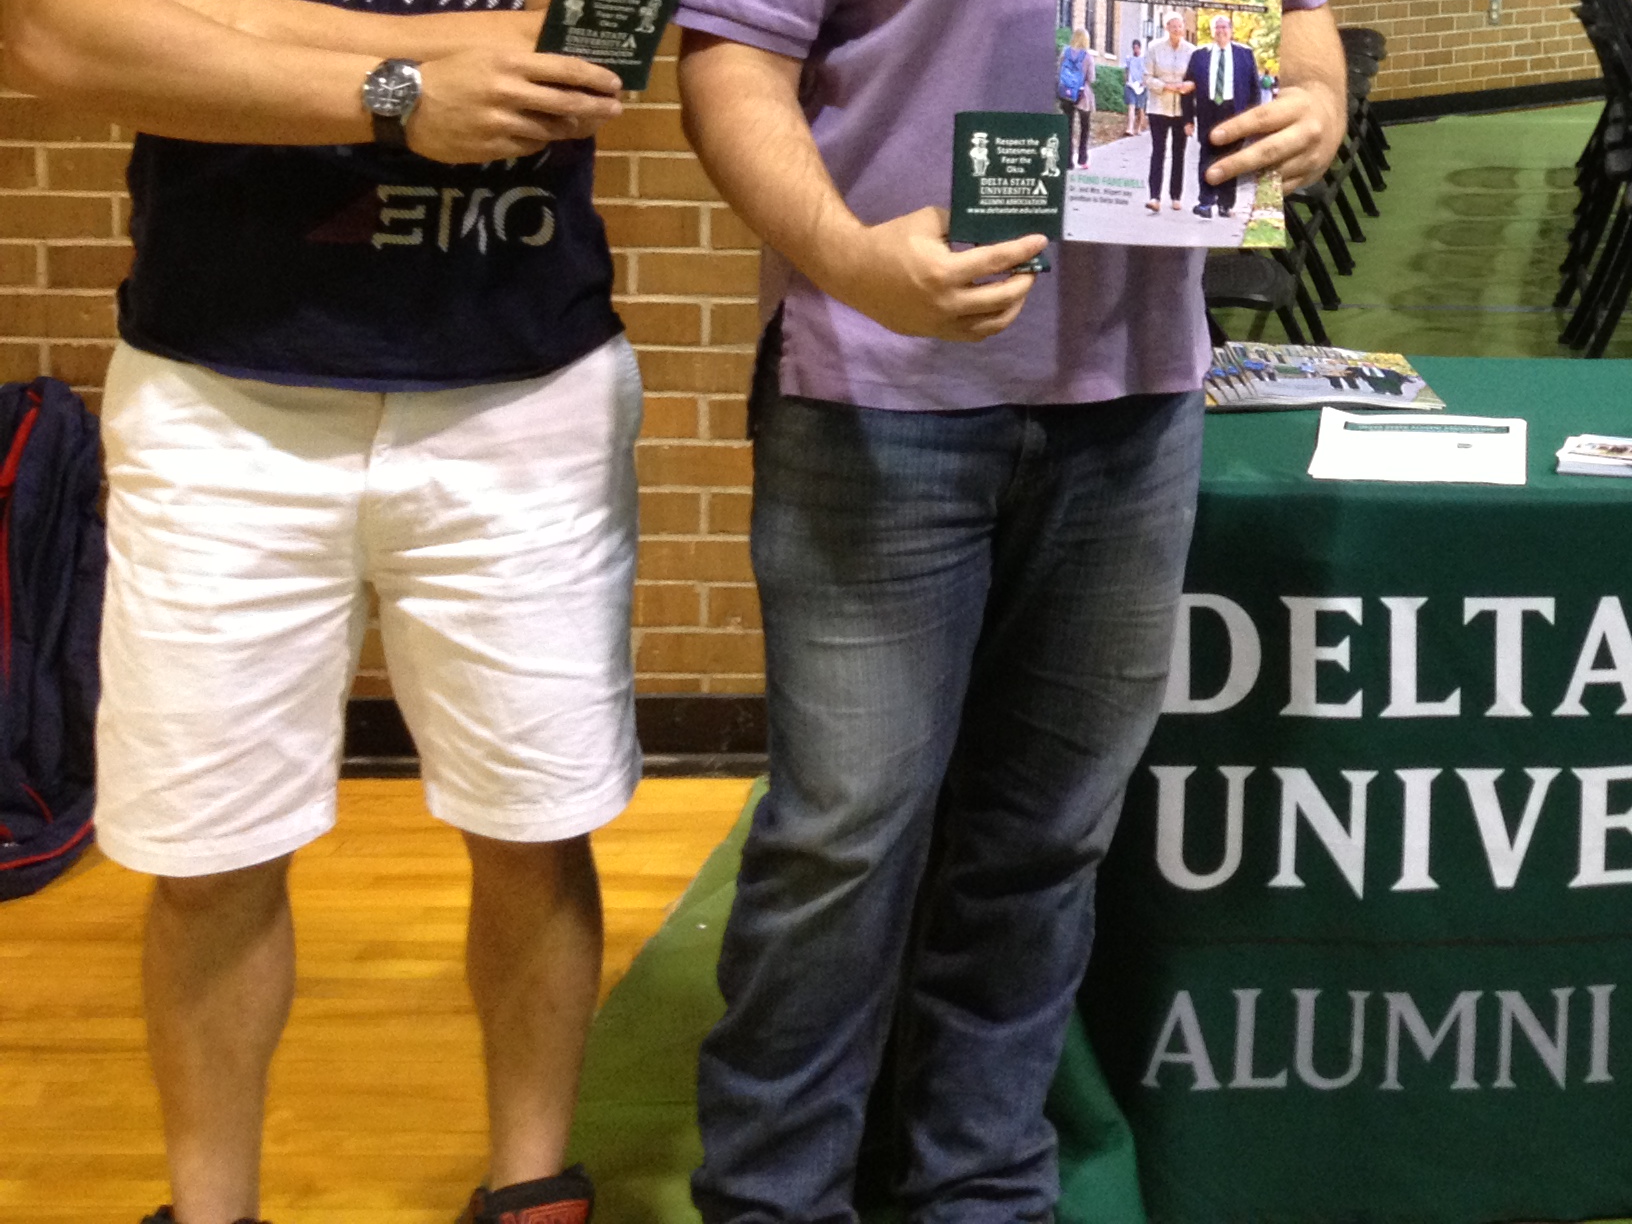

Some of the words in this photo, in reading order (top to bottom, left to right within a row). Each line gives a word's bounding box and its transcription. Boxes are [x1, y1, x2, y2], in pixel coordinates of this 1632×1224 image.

[995, 137, 1026, 147] Respect
[1027, 138, 1039, 146] the
[1001, 156, 1018, 164] Fear
[1020, 156, 1032, 164] the
[980, 177, 1009, 187] DELTA
[1010, 177, 1036, 187] STATE
[980, 186, 1032, 195] UNIVERSITY
[1140, 983, 1618, 1092] ALUMNI
